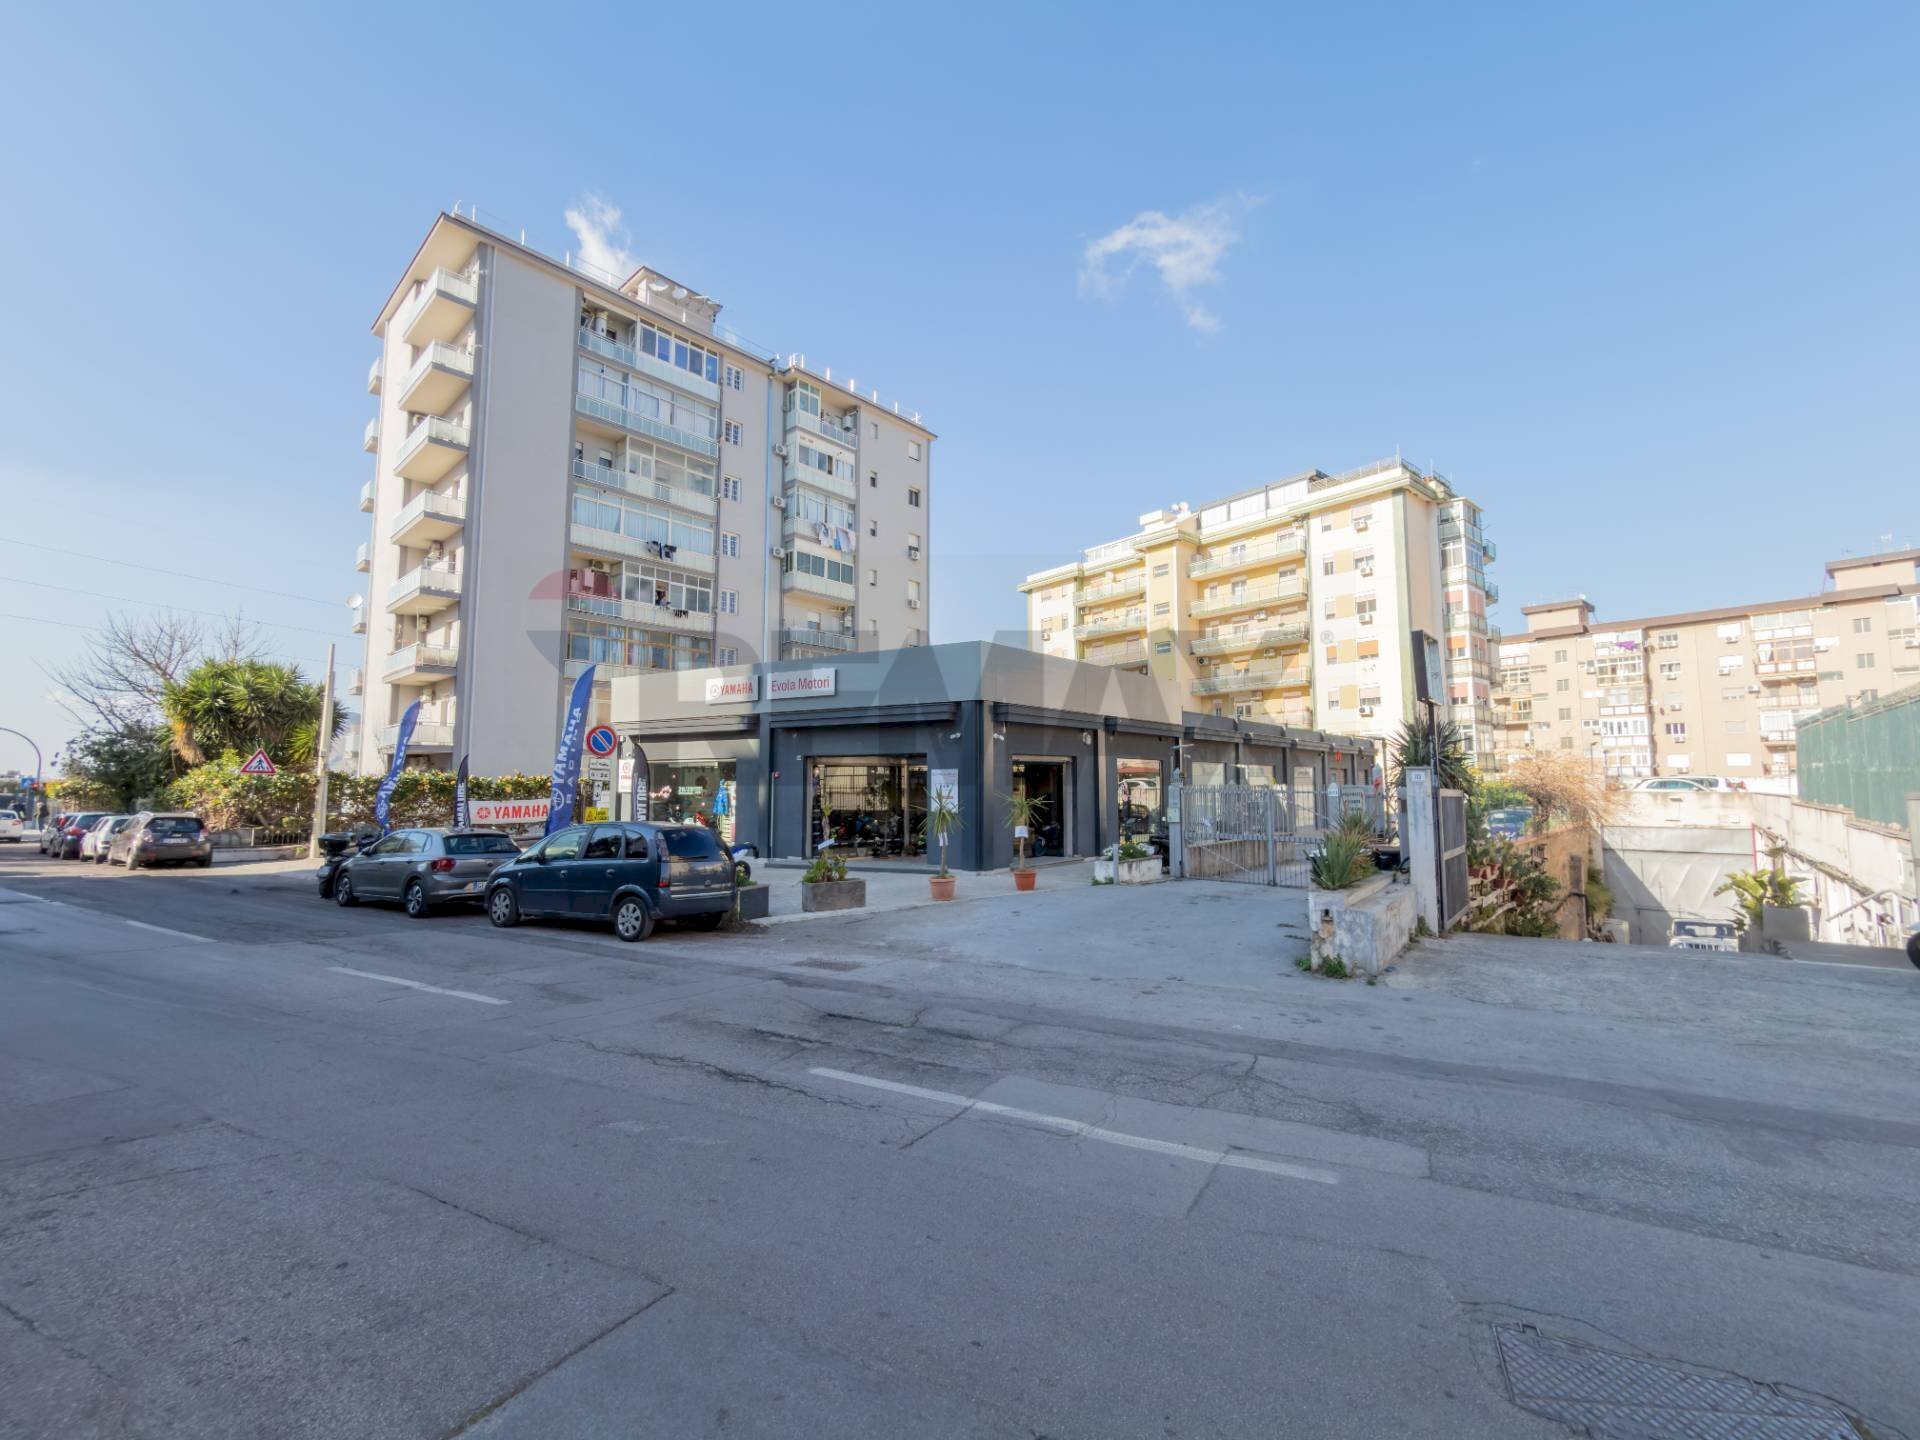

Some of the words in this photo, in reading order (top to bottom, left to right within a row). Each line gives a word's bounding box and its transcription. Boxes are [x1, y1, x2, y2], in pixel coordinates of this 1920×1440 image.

[721, 682, 753, 696] YAMAHA
[771, 680, 796, 692] Evola
[799, 677, 830, 690] Motori
[552, 707, 581, 785] YAMAHA
[494, 804, 548, 819] YAMAHA
